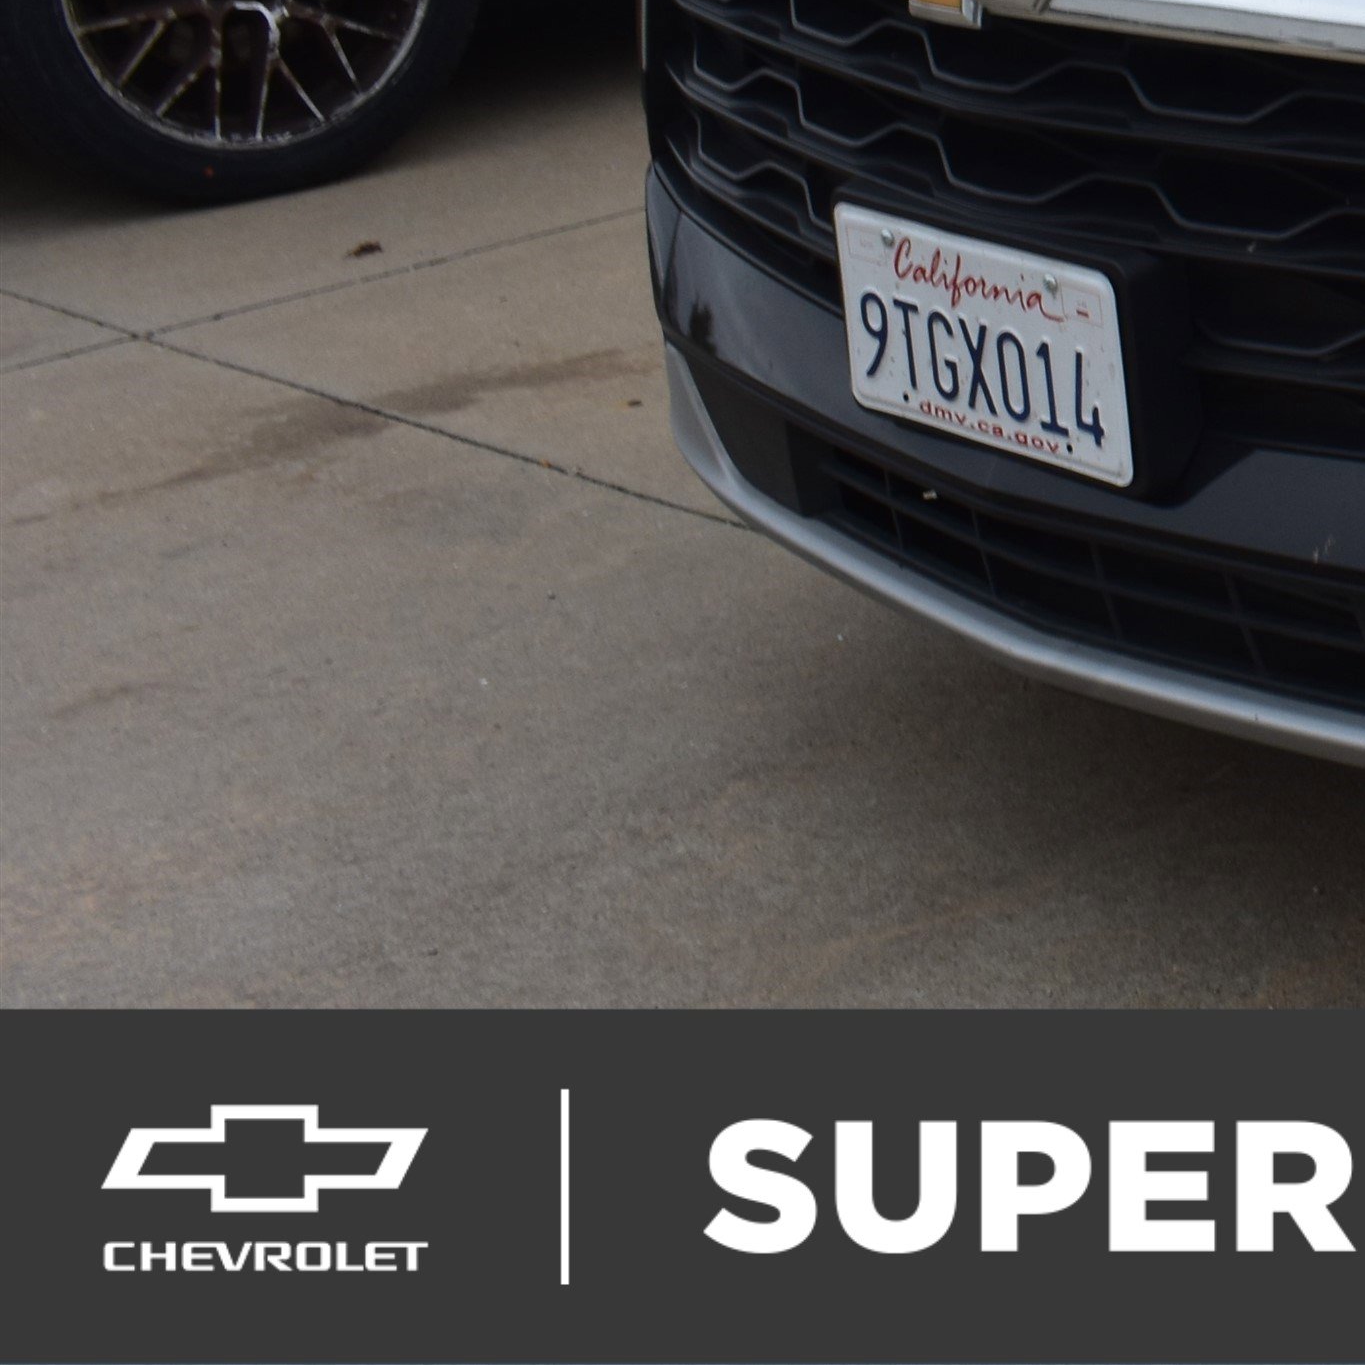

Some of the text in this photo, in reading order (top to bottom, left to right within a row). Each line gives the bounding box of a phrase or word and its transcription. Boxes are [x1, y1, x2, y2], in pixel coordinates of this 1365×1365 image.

[893, 237, 1064, 322] California
[860, 291, 1105, 447] 9TGX014
[919, 400, 1060, 454] dmv.ca.gov
